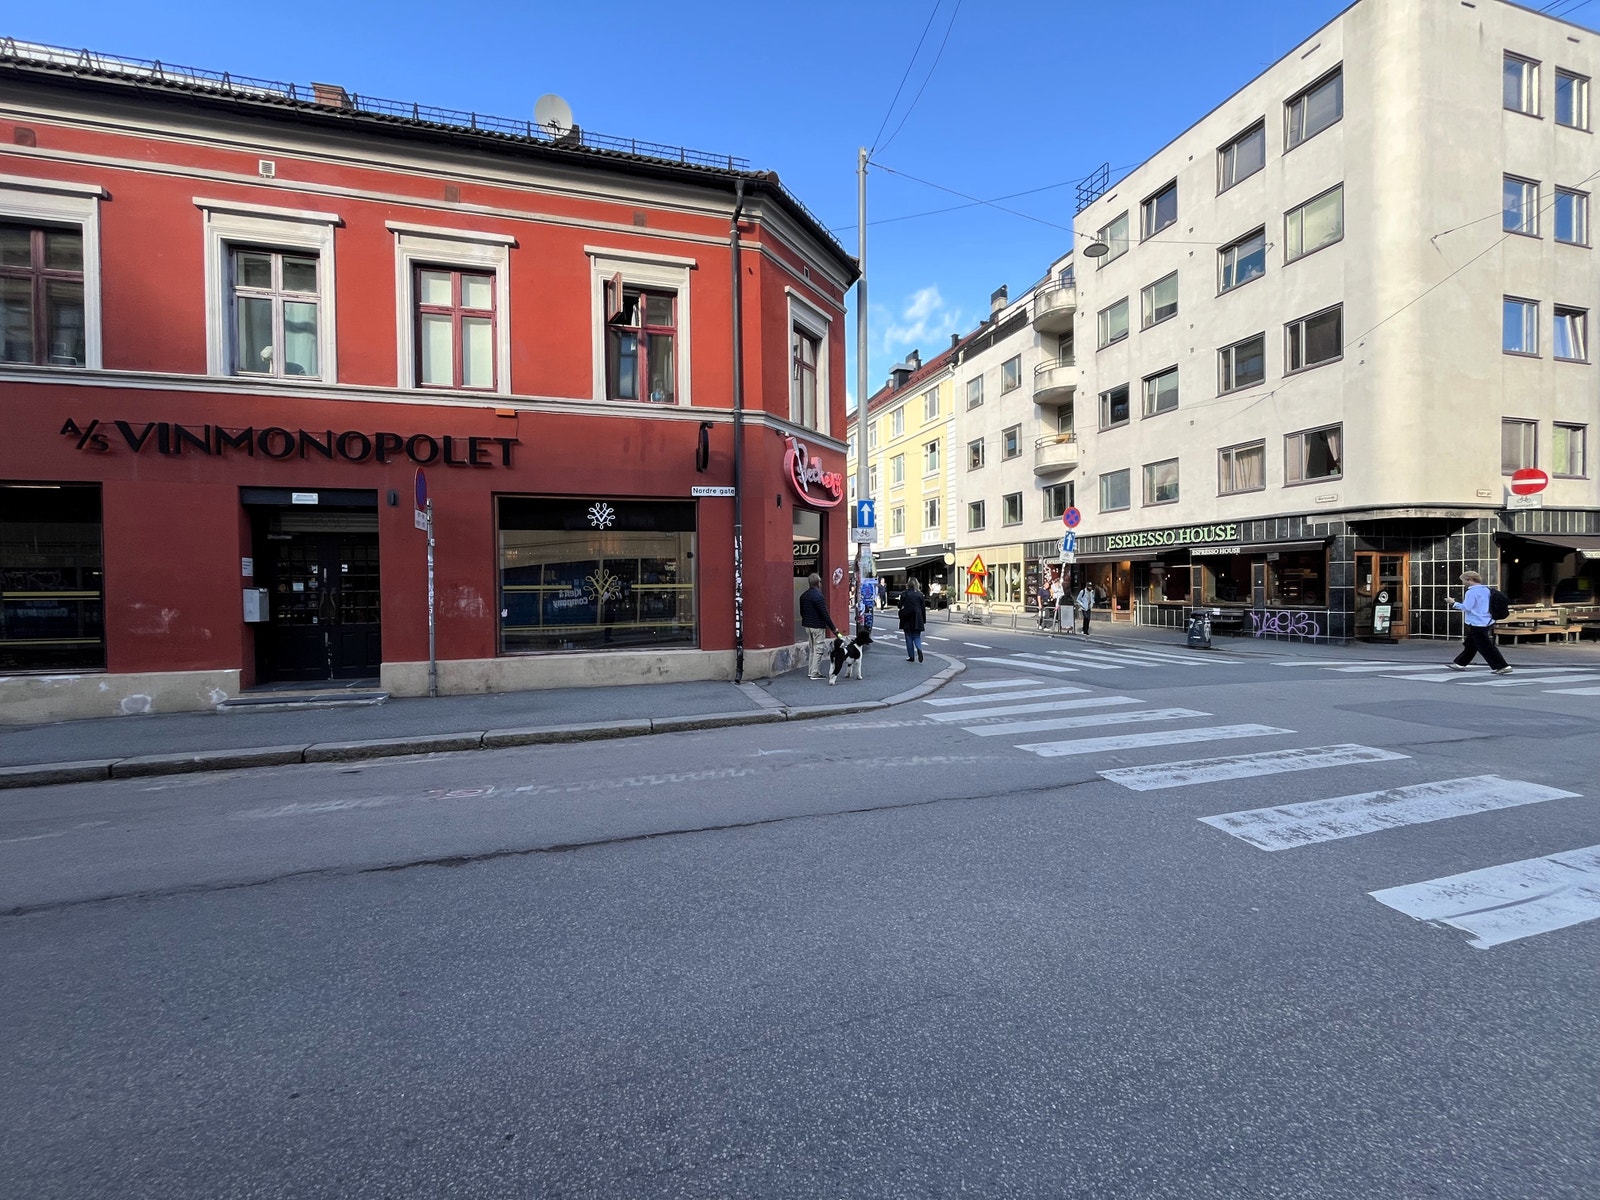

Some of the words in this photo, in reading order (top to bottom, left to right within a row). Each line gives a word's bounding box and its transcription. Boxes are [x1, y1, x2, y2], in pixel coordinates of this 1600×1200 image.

[114, 420, 519, 467] VINMONOPOLET
[1107, 531, 1176, 550] ESPRESSO
[1178, 524, 1238, 544] HOUSE
[1192, 548, 1219, 556] ESPRESSO
